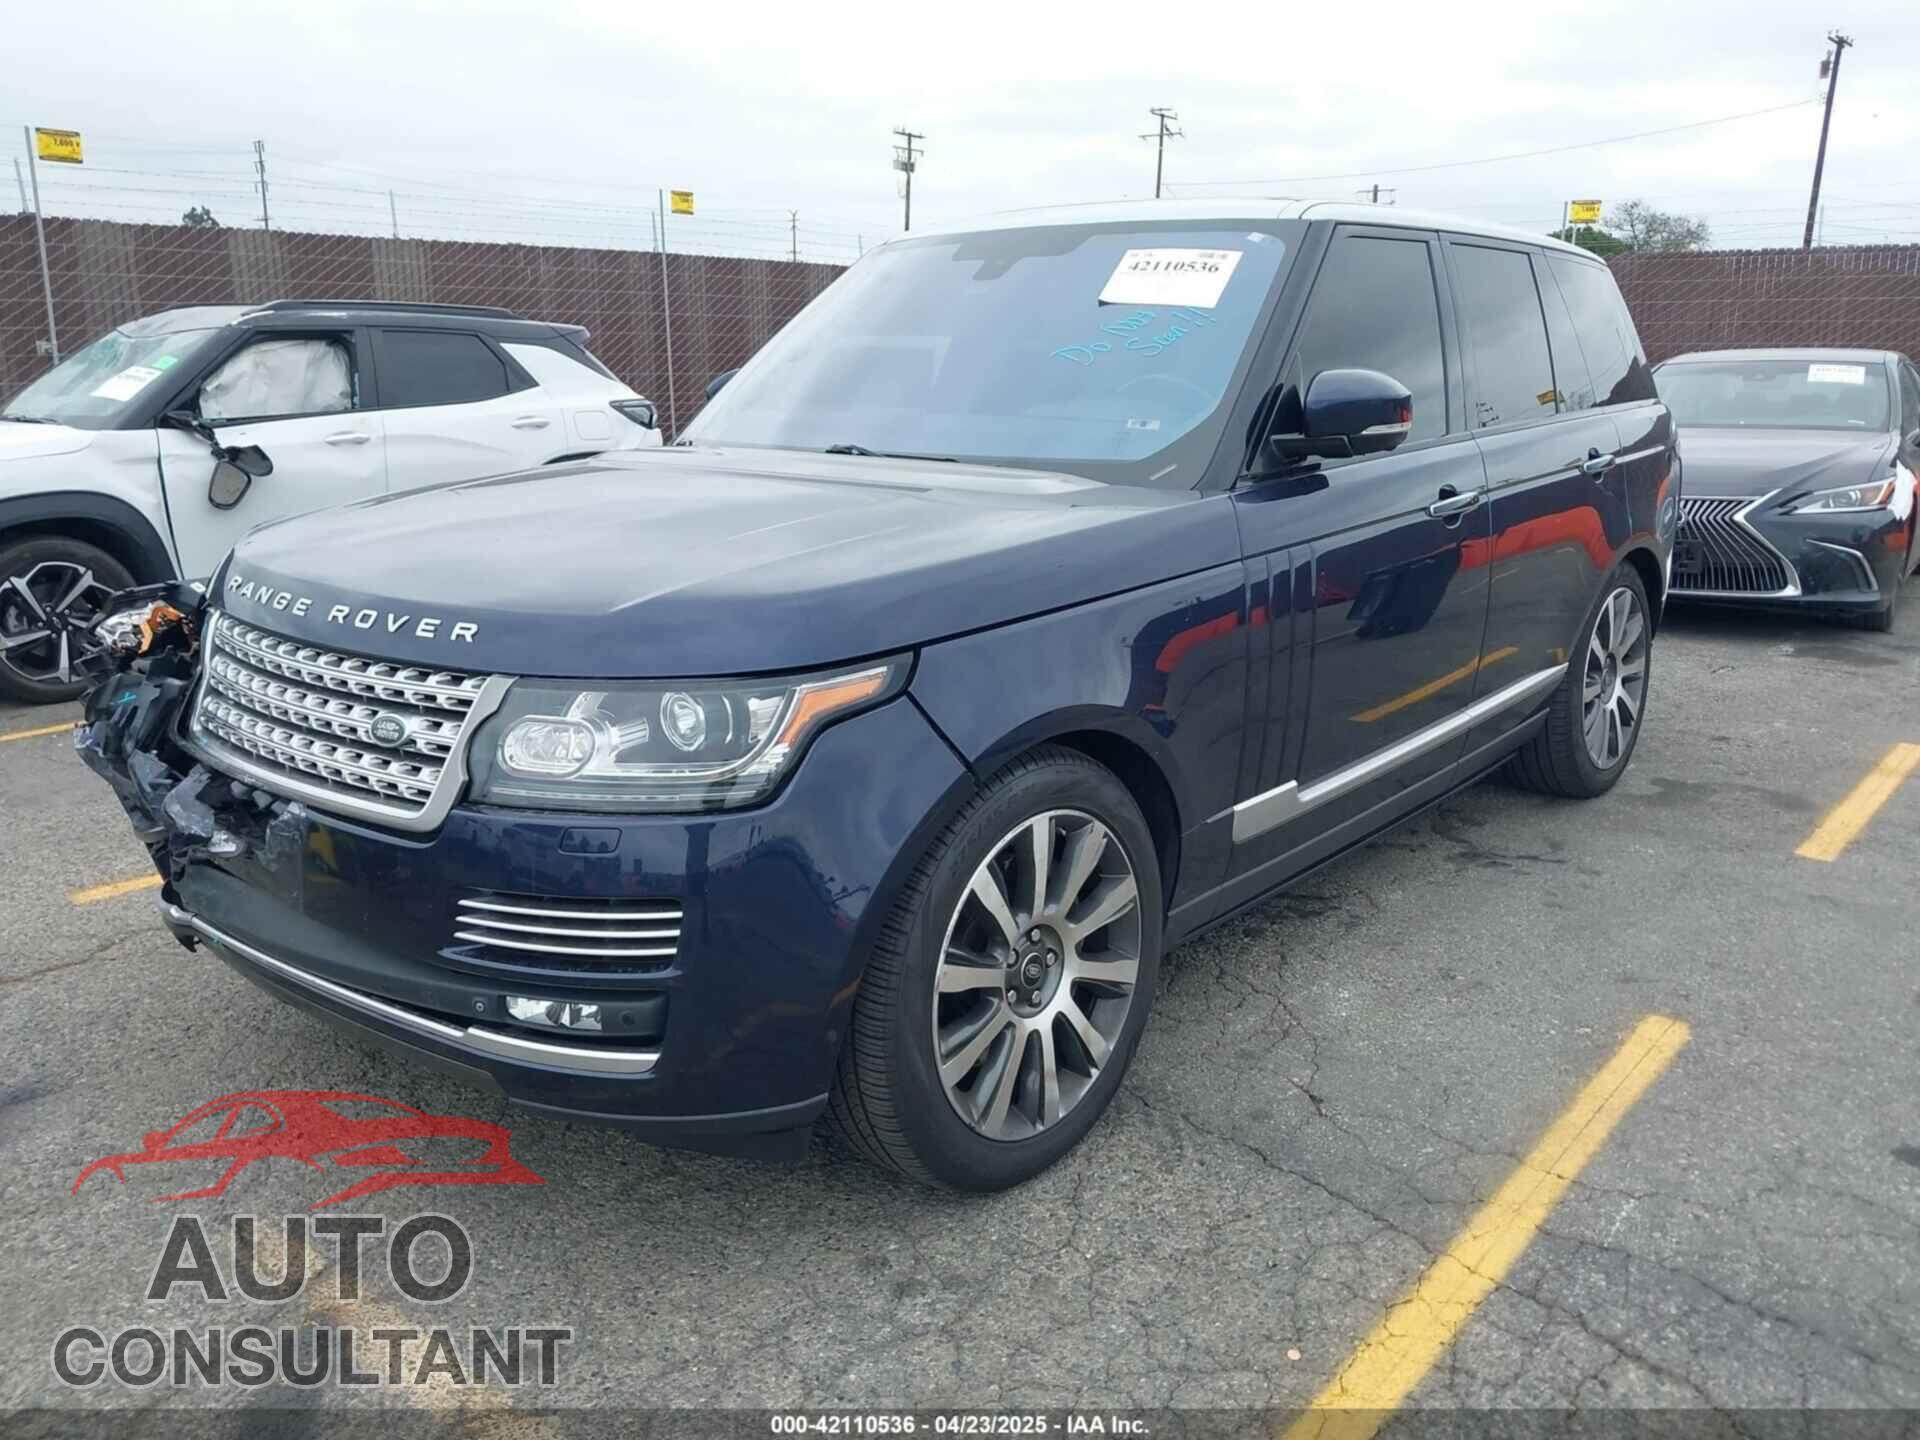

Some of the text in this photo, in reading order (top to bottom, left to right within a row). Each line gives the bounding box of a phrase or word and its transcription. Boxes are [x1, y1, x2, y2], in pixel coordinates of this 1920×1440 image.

[1128, 261, 1220, 273] 42110536
[227, 575, 480, 643] RANGE ROVER
